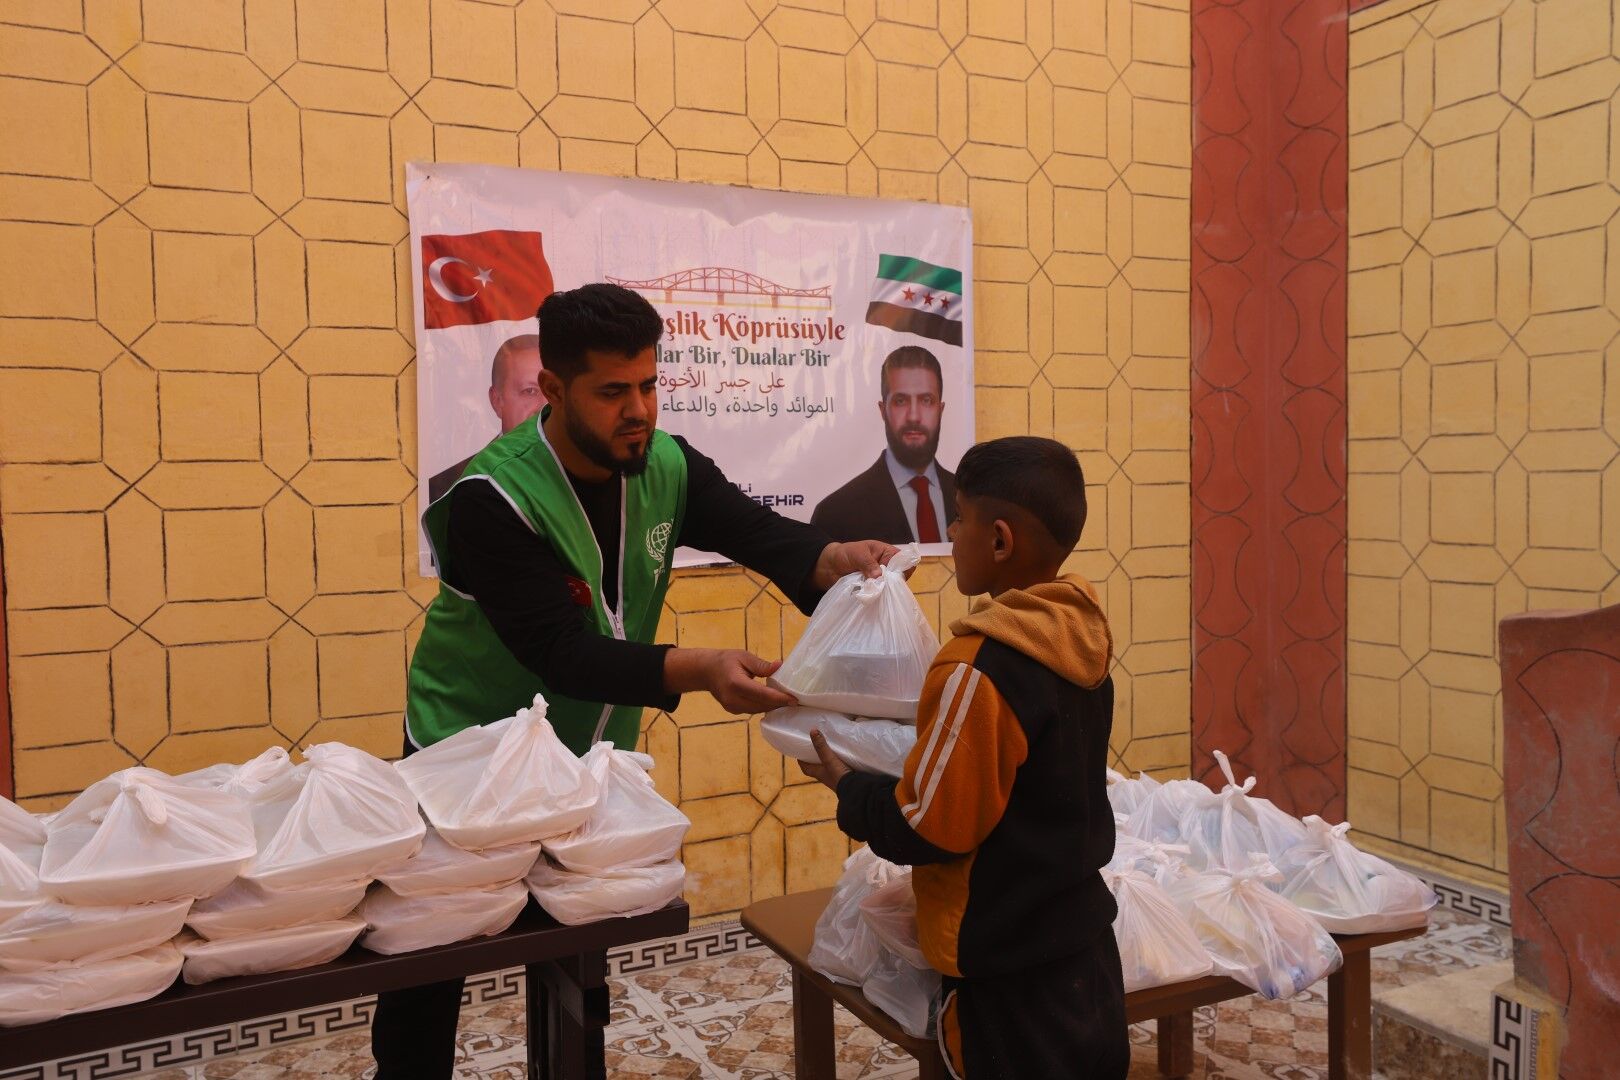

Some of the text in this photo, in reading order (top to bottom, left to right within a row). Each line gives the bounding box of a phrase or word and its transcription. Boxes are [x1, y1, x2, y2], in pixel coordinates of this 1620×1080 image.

[661, 310, 846, 345] şlik Köprüsüyle
[657, 343, 831, 367] lar Bir, Dualar Bir
[659, 366, 786, 394] على جسر الأخوة
[662, 394, 717, 416] والدعاء
[786, 396, 834, 418] الموائد
